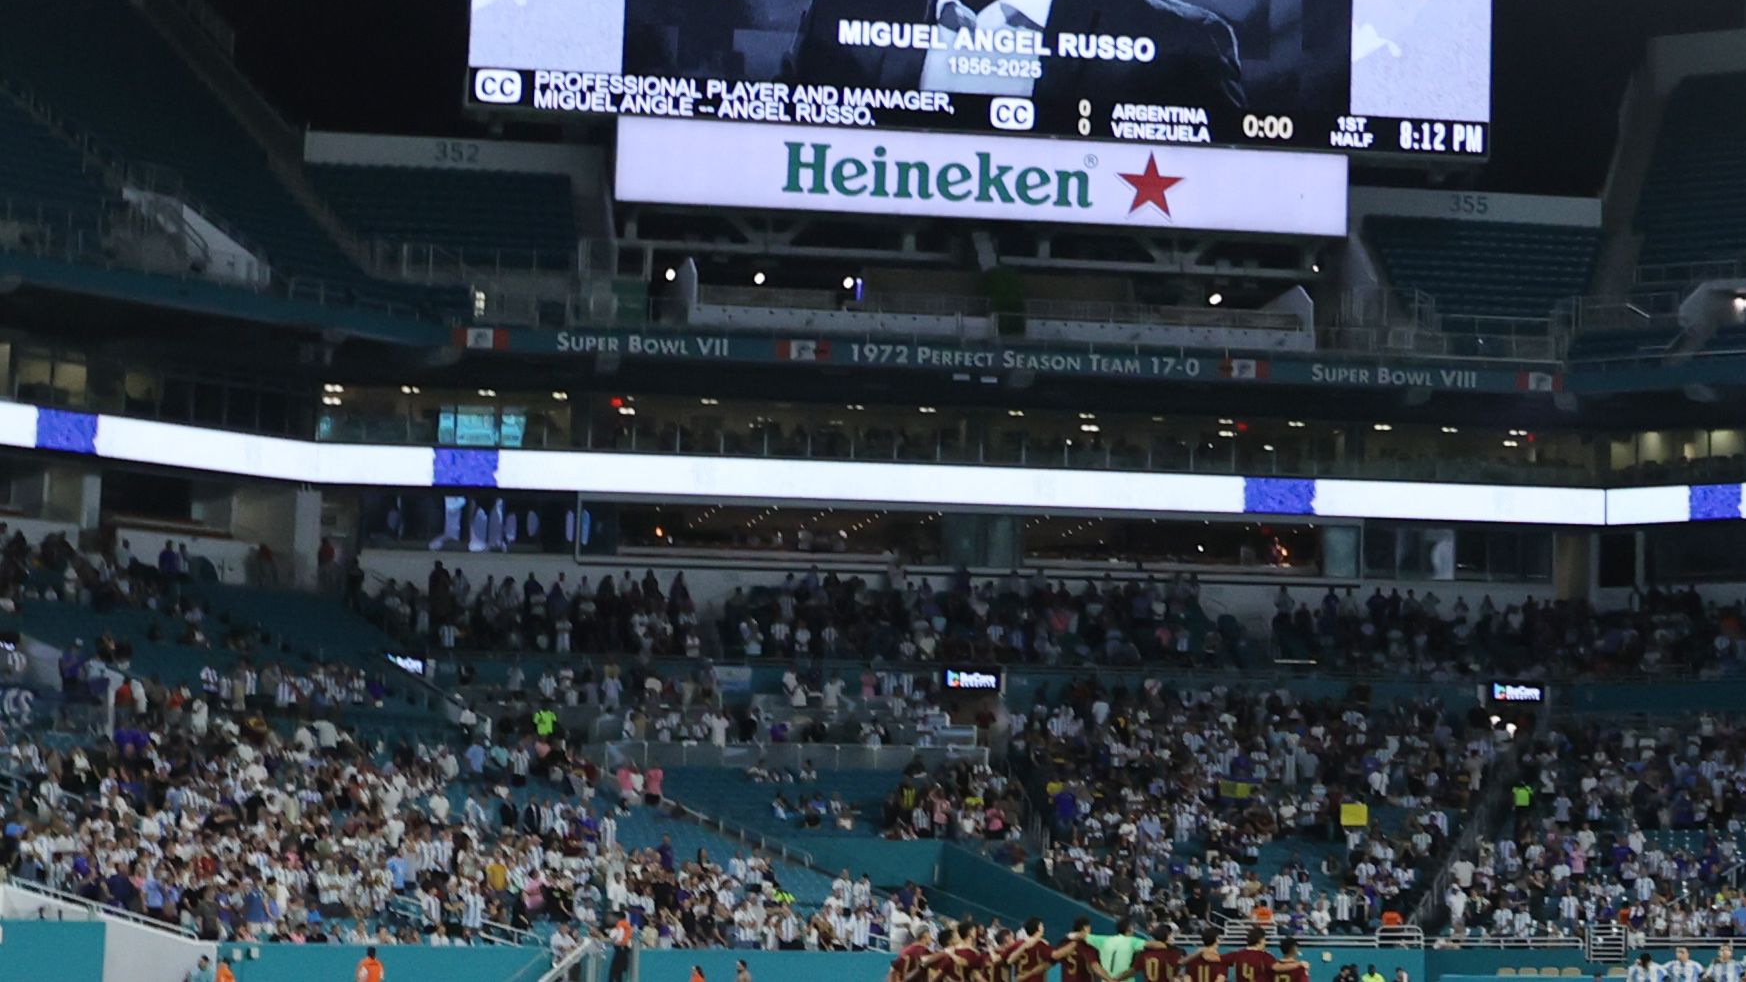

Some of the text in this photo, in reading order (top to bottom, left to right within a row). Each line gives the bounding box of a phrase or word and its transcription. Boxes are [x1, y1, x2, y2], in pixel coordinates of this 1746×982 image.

[838, 19, 1156, 62] MIGUEL ANGEL RUSSO
[948, 57, 1042, 79] 1956-2025
[480, 75, 516, 99] CC
[535, 70, 955, 115] PROFESSIONAL PLAYER AND MANAGER,
[533, 89, 617, 113] MIGUEL
[619, 95, 694, 117] ANGLE
[718, 99, 791, 122] ANGEL
[795, 105, 876, 126] RUSSO.
[995, 103, 1030, 126] CC
[1077, 99, 1209, 125] 0 ARGENTINA
[1077, 117, 1211, 143] 0 VENEZUELA
[1242, 114, 1294, 139] 0:00
[1336, 116, 1367, 132] 1ST
[1329, 131, 1374, 148] HALF
[1399, 120, 1484, 153] 8:12 PM
[434, 140, 480, 164] 352
[782, 141, 1094, 209] Heineken
[1449, 193, 1488, 215] 355
[695, 337, 729, 357] VII
[850, 343, 910, 364] 1972
[1150, 356, 1200, 377] 17-0
[1440, 369, 1477, 389] VIII
